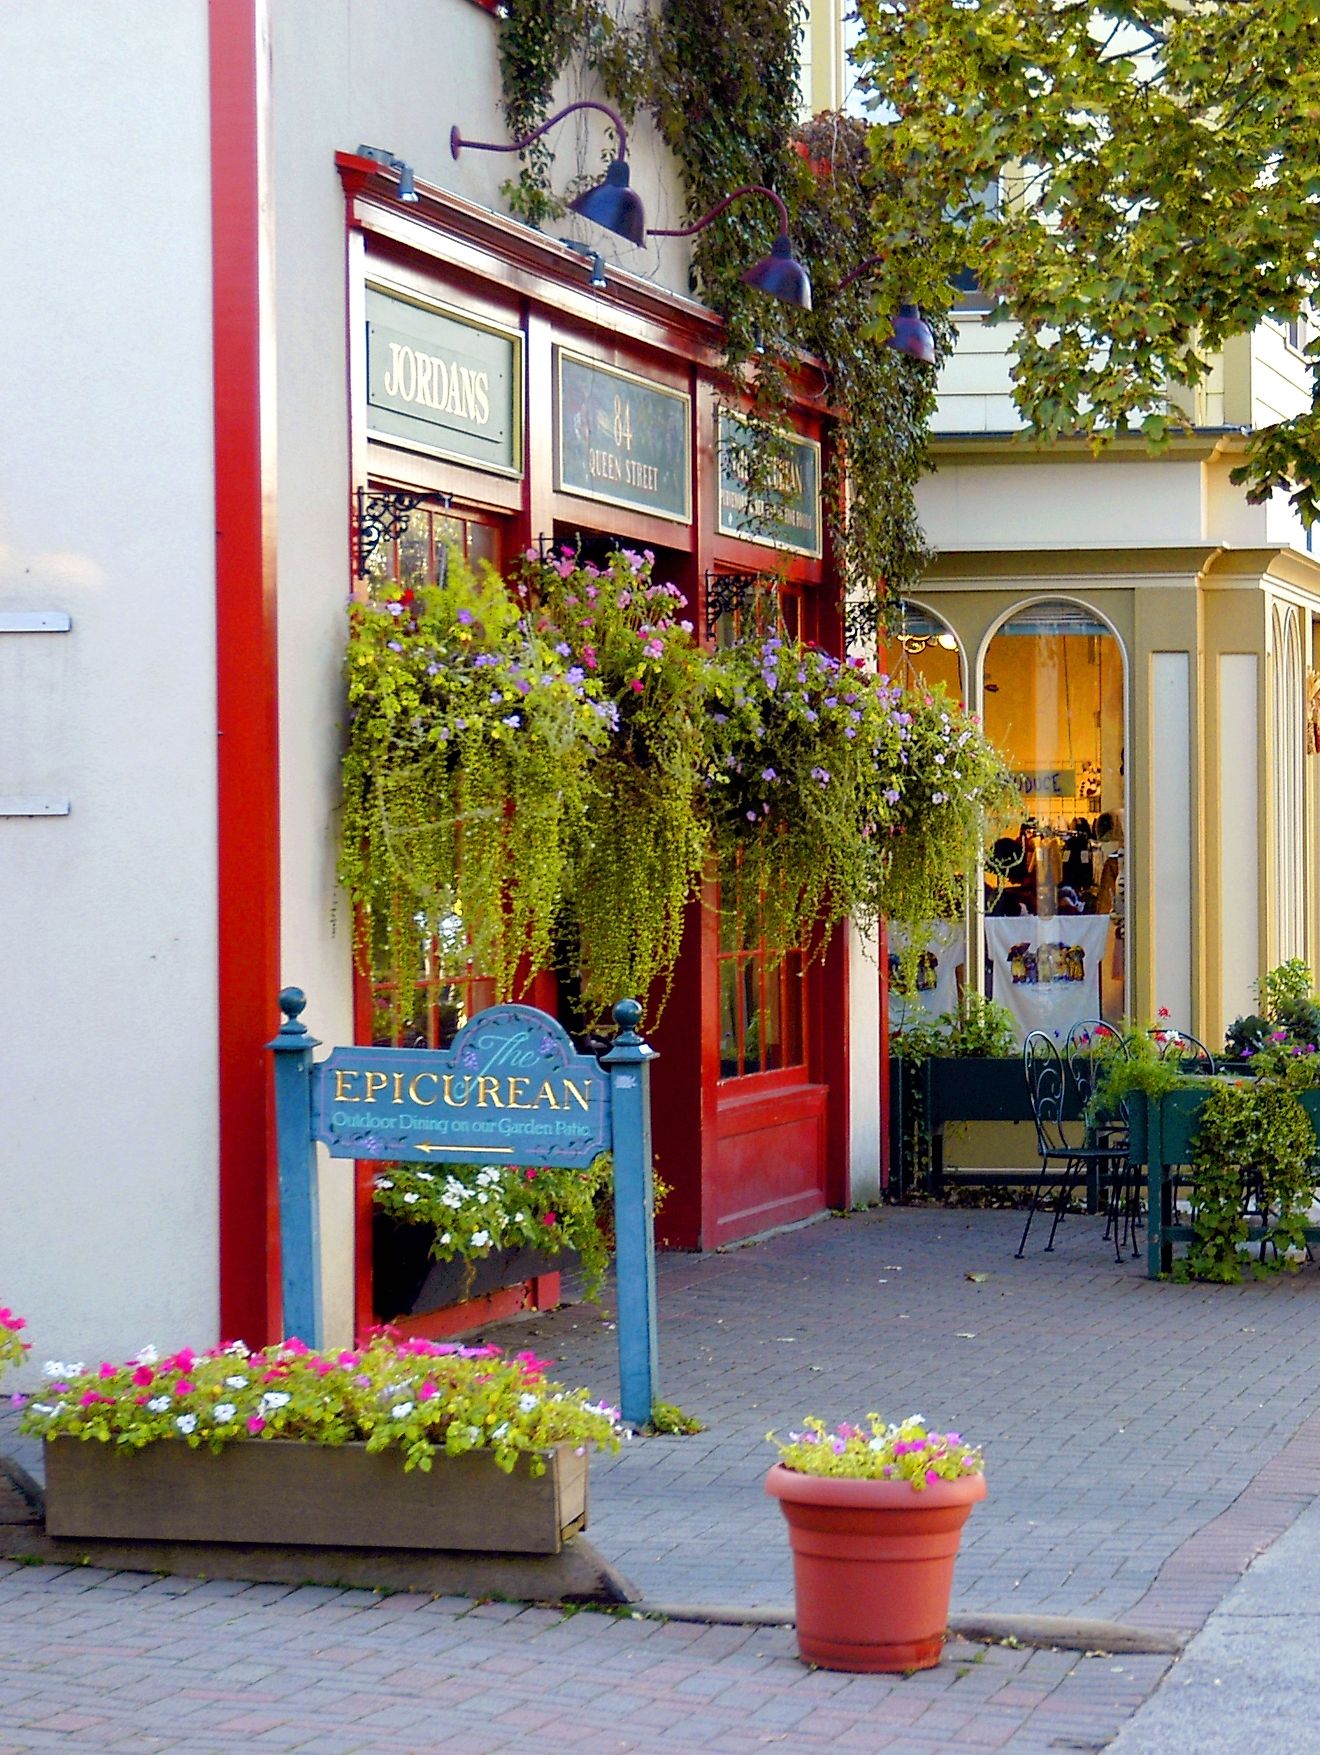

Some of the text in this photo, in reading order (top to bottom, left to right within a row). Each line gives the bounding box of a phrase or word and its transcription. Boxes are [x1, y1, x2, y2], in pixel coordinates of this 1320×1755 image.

[384, 342, 490, 425] JORDANS
[613, 394, 633, 451] 84
[589, 448, 659, 492] QUEEN STREET
[333, 1069, 593, 1112] EPICUREAN
[454, 1031, 541, 1100] The
[332, 1112, 397, 1129] Outdoor
[399, 1114, 449, 1134] Dining
[450, 1120, 470, 1133] on
[472, 1120, 497, 1133] our
[498, 1117, 553, 1137] Garden
